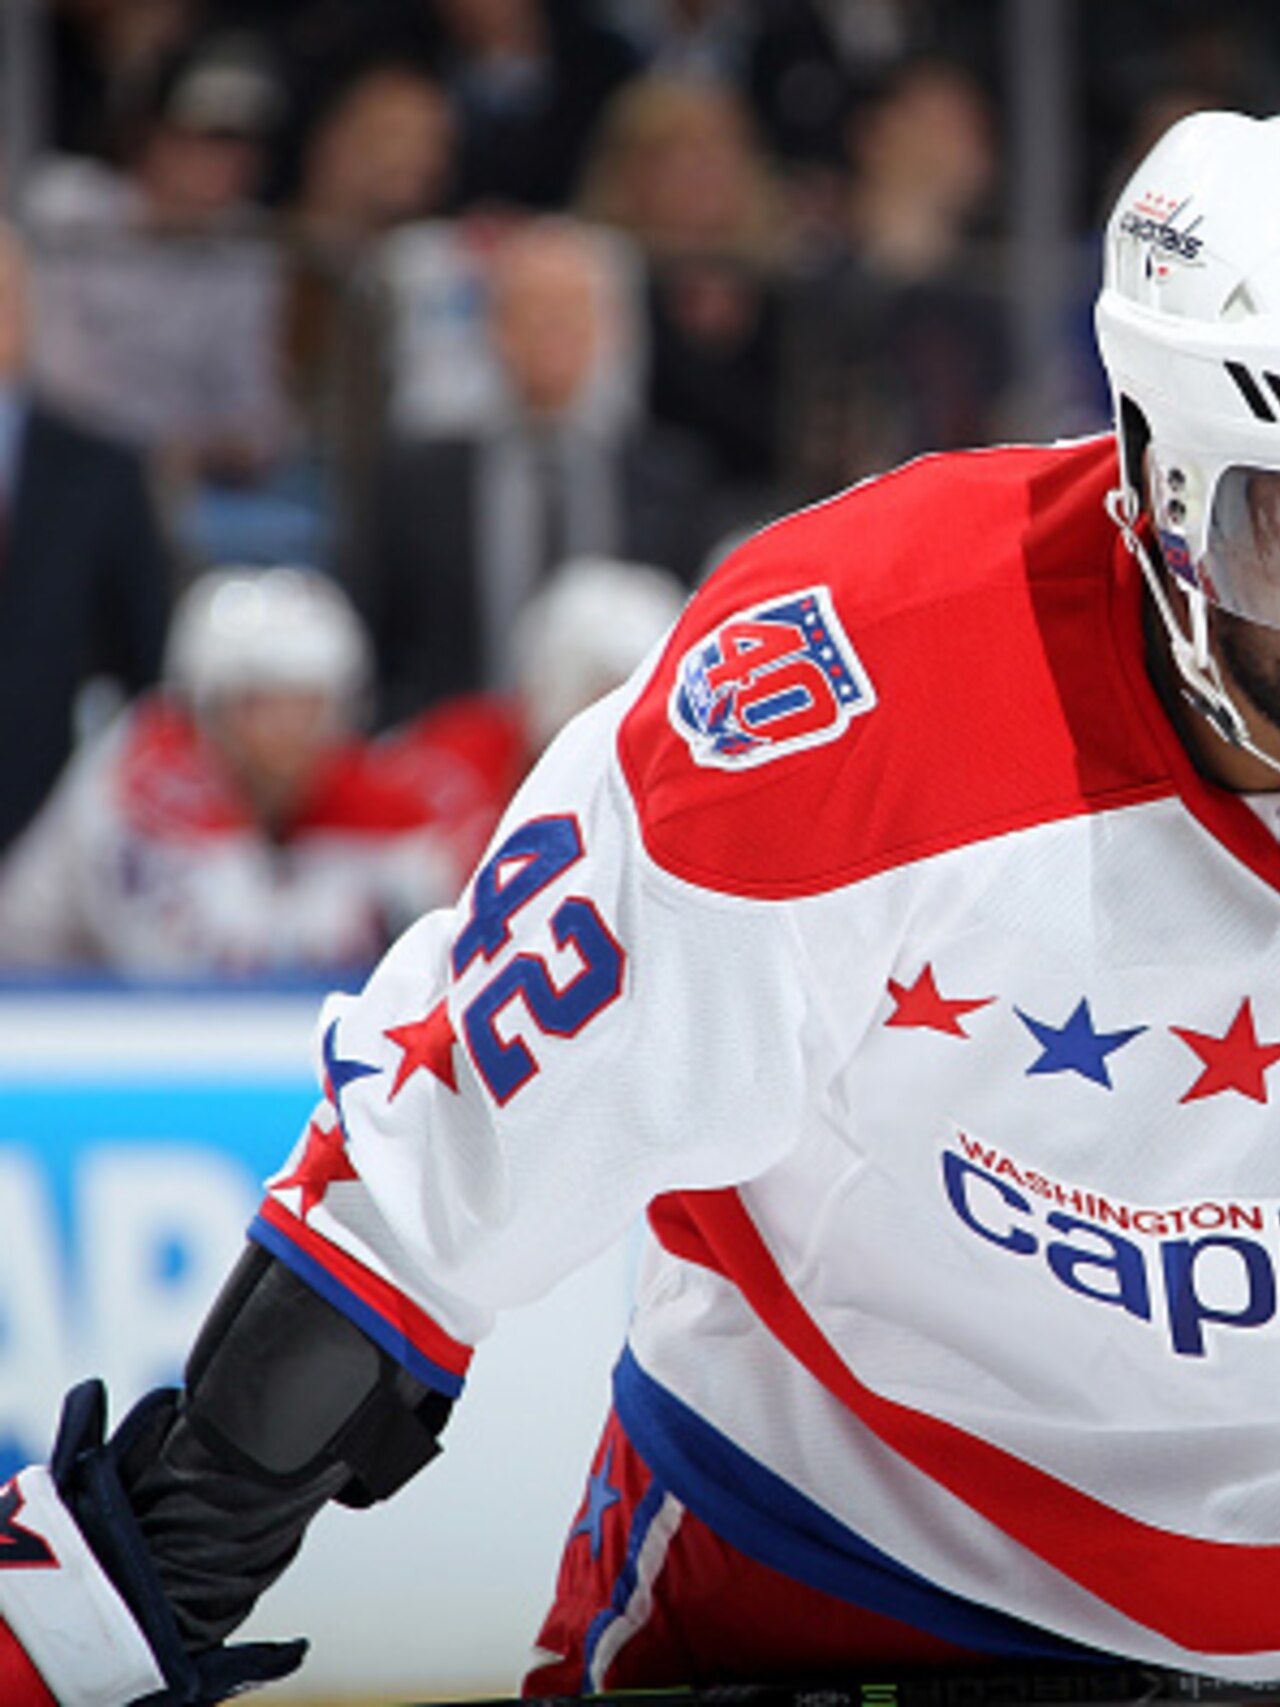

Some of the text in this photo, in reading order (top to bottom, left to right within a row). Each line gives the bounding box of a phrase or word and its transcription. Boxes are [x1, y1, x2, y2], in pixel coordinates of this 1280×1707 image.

[706, 621, 838, 746] 40
[451, 811, 628, 1108] 42
[957, 1130, 1264, 1235] WASHINGTON
